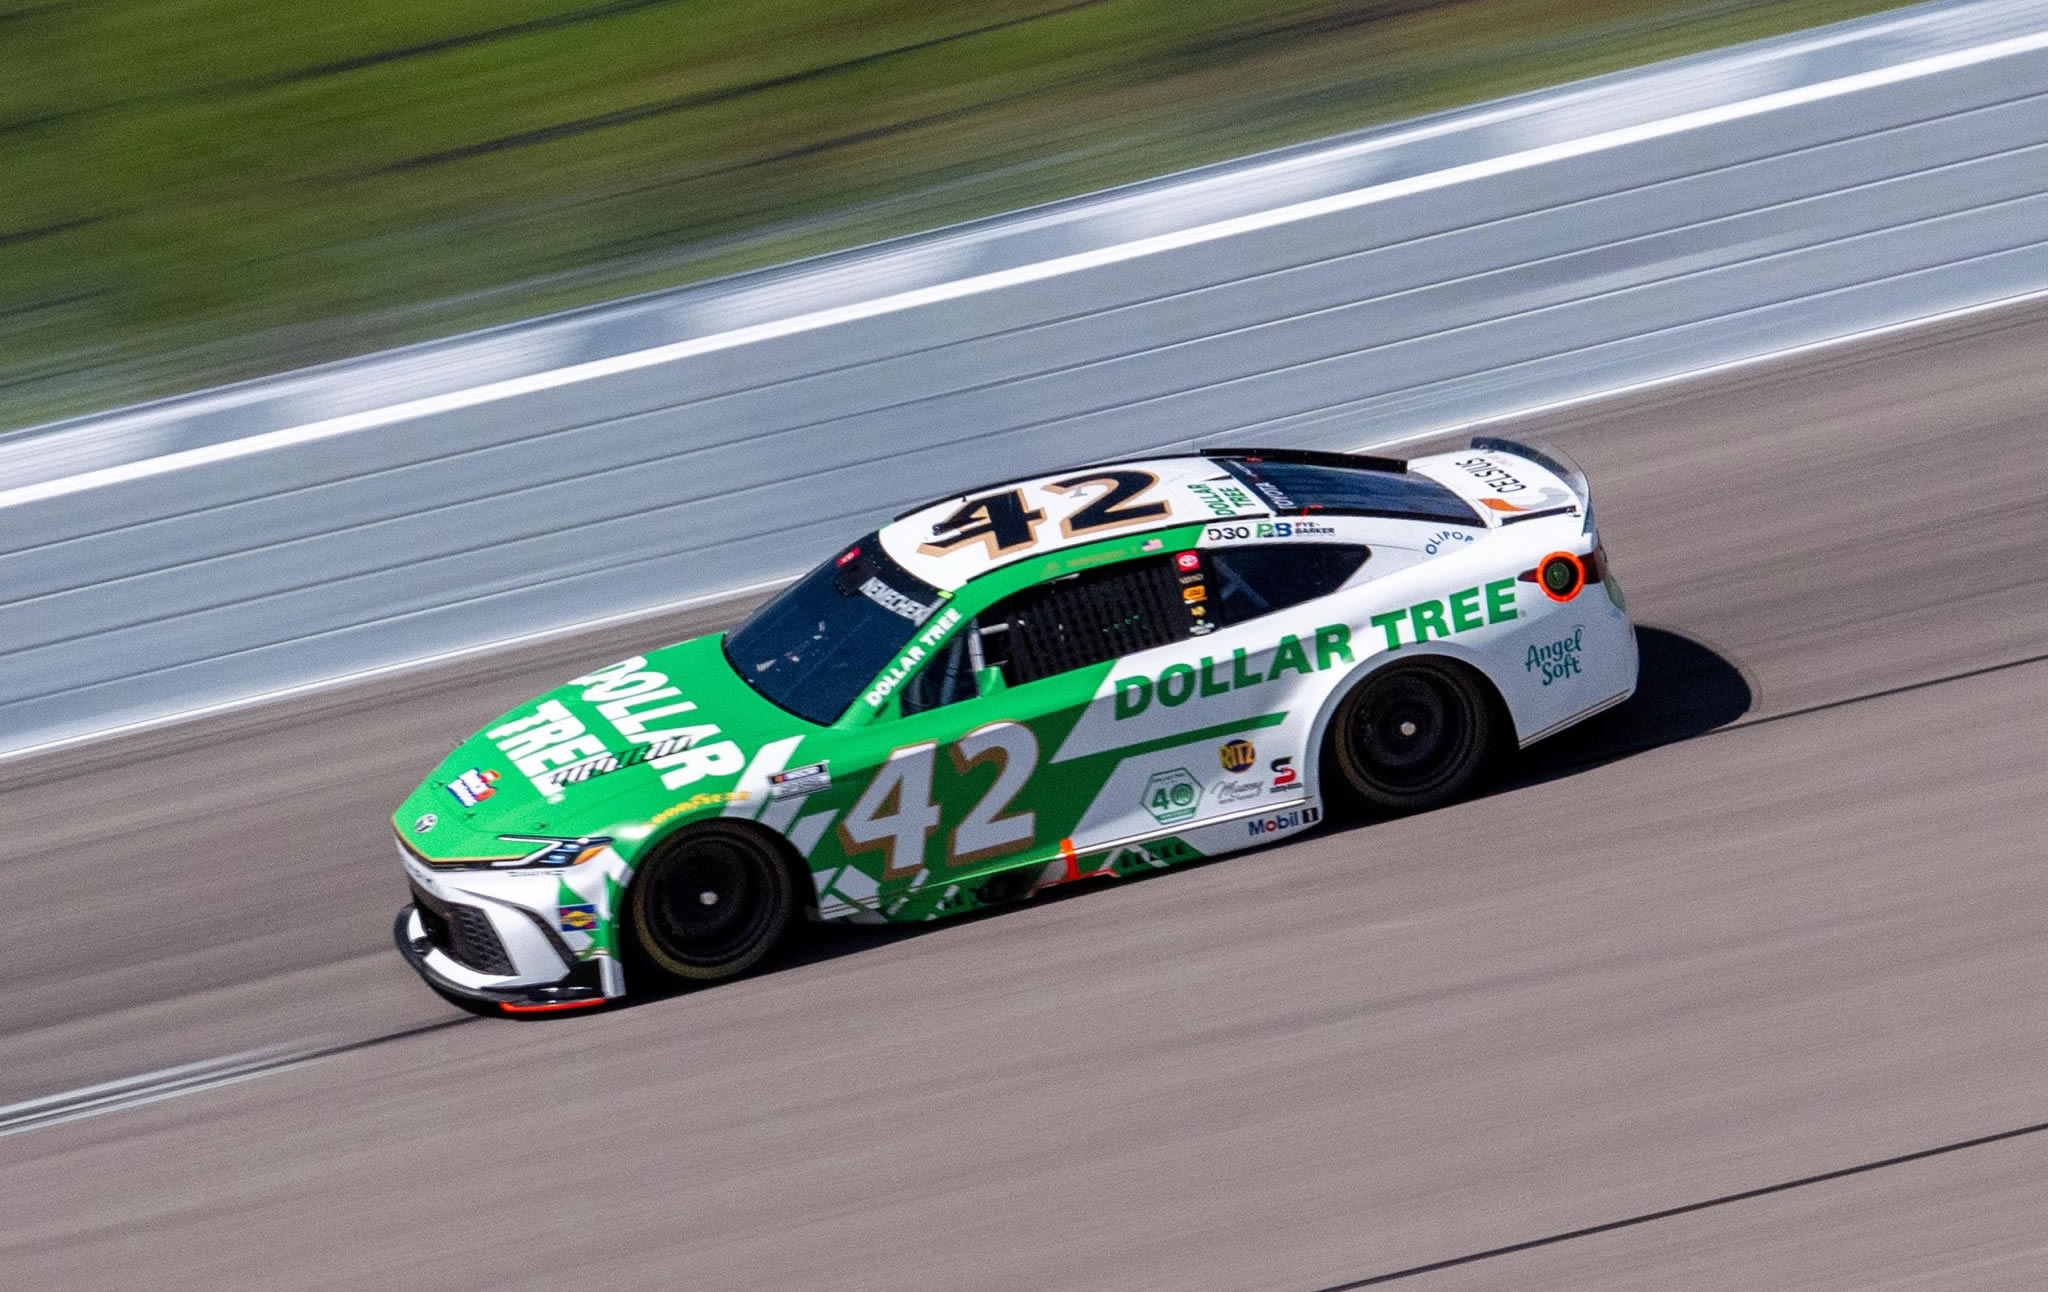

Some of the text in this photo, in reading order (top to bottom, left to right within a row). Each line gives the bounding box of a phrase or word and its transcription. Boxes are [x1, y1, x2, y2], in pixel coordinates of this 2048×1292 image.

[1218, 487, 1256, 508] TREE
[1454, 457, 1527, 493] CELSIUS
[916, 469, 1172, 560] 42
[1187, 483, 1237, 516] DOLLAR
[1425, 531, 1475, 555] OLIPOP
[864, 607, 963, 707] DOLLAR TREE
[1114, 576, 1519, 721] DOLLAR TREE
[1525, 626, 1582, 672] Angel
[1542, 653, 1583, 686] Soft
[567, 655, 746, 791] DOLLAR
[485, 699, 620, 798] TREE
[836, 718, 1040, 881] 42
[1247, 807, 1318, 836] Mobil 1
